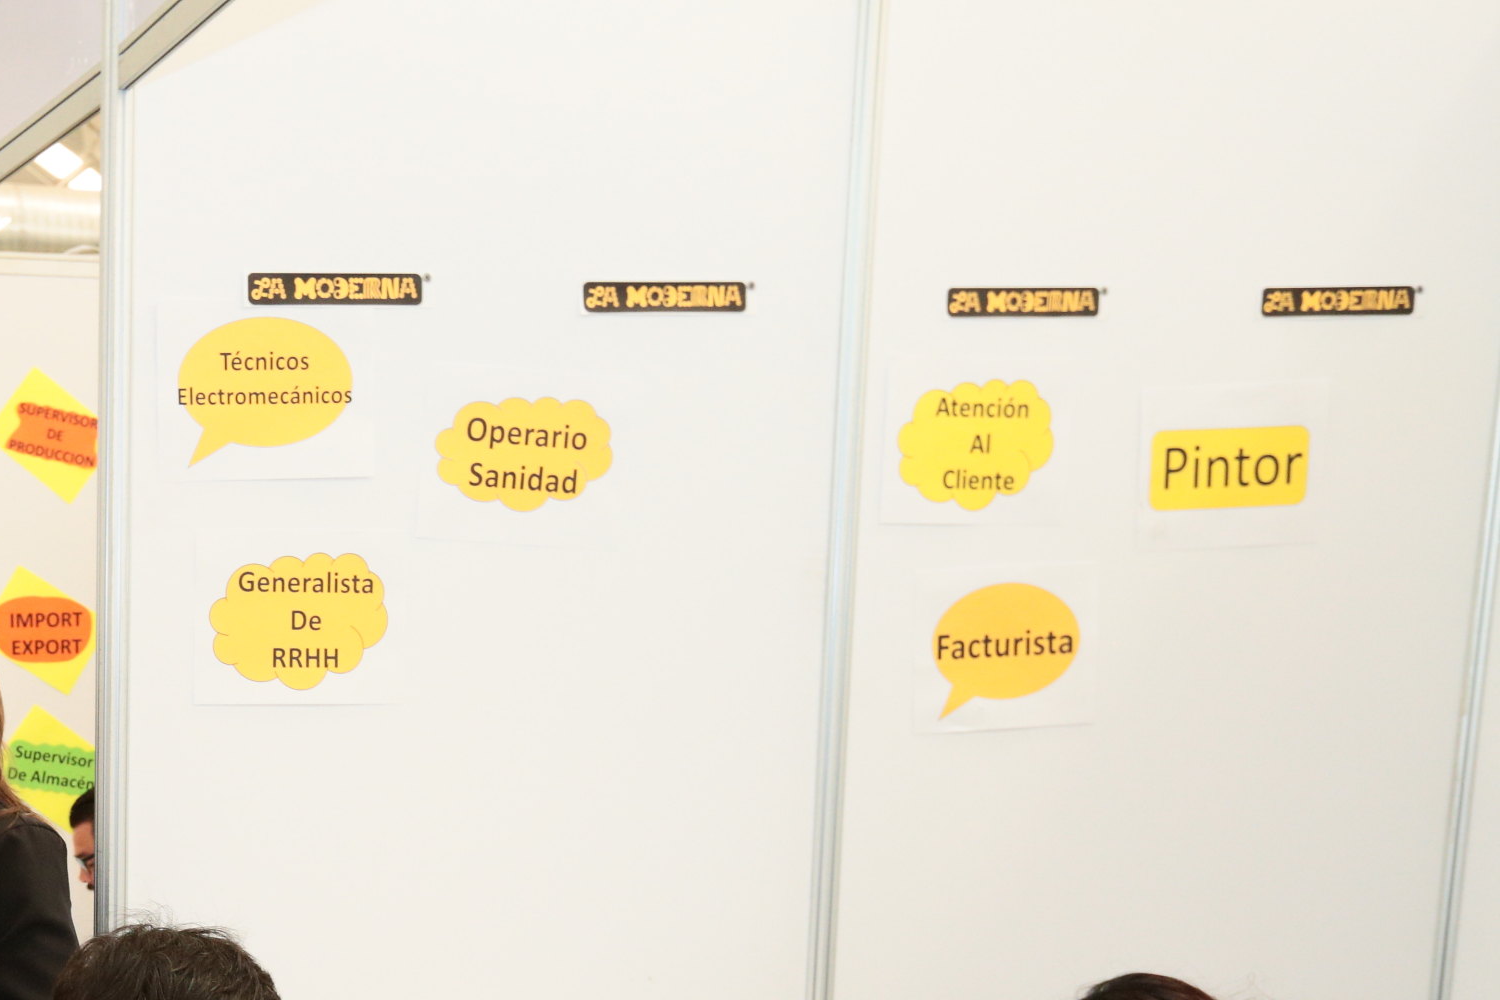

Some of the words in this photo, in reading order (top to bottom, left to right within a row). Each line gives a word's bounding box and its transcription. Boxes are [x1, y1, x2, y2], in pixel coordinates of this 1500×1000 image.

[251, 277, 287, 300] LA
[294, 277, 418, 300] MODERNA
[586, 286, 618, 308] LA
[626, 285, 742, 307] MODERNA
[949, 291, 981, 313] LA
[986, 290, 1096, 312] MODERNA
[1263, 291, 1294, 313] LA
[1300, 290, 1411, 312] MODERNA
[220, 350, 309, 371] Técnicos
[178, 385, 353, 406] Electromecánicos
[19, 402, 98, 429] SUPERVISOR
[936, 396, 1030, 419] Atención
[46, 428, 64, 441] DE
[467, 417, 588, 451] Operario
[969, 433, 991, 455] Al
[469, 462, 578, 495] Sanidad
[1164, 445, 1303, 490] Pintor
[943, 469, 1014, 491] Cliente
[239, 571, 374, 594] Generalista
[10, 611, 83, 629] IMPORT
[291, 609, 322, 631] De
[11, 638, 82, 656] EXPORT
[938, 629, 1074, 661] Facturista
[272, 647, 339, 669] RRHH
[15, 745, 95, 769] Supervisor
[8, 767, 27, 781] De
[30, 770, 95, 790] Almacén
